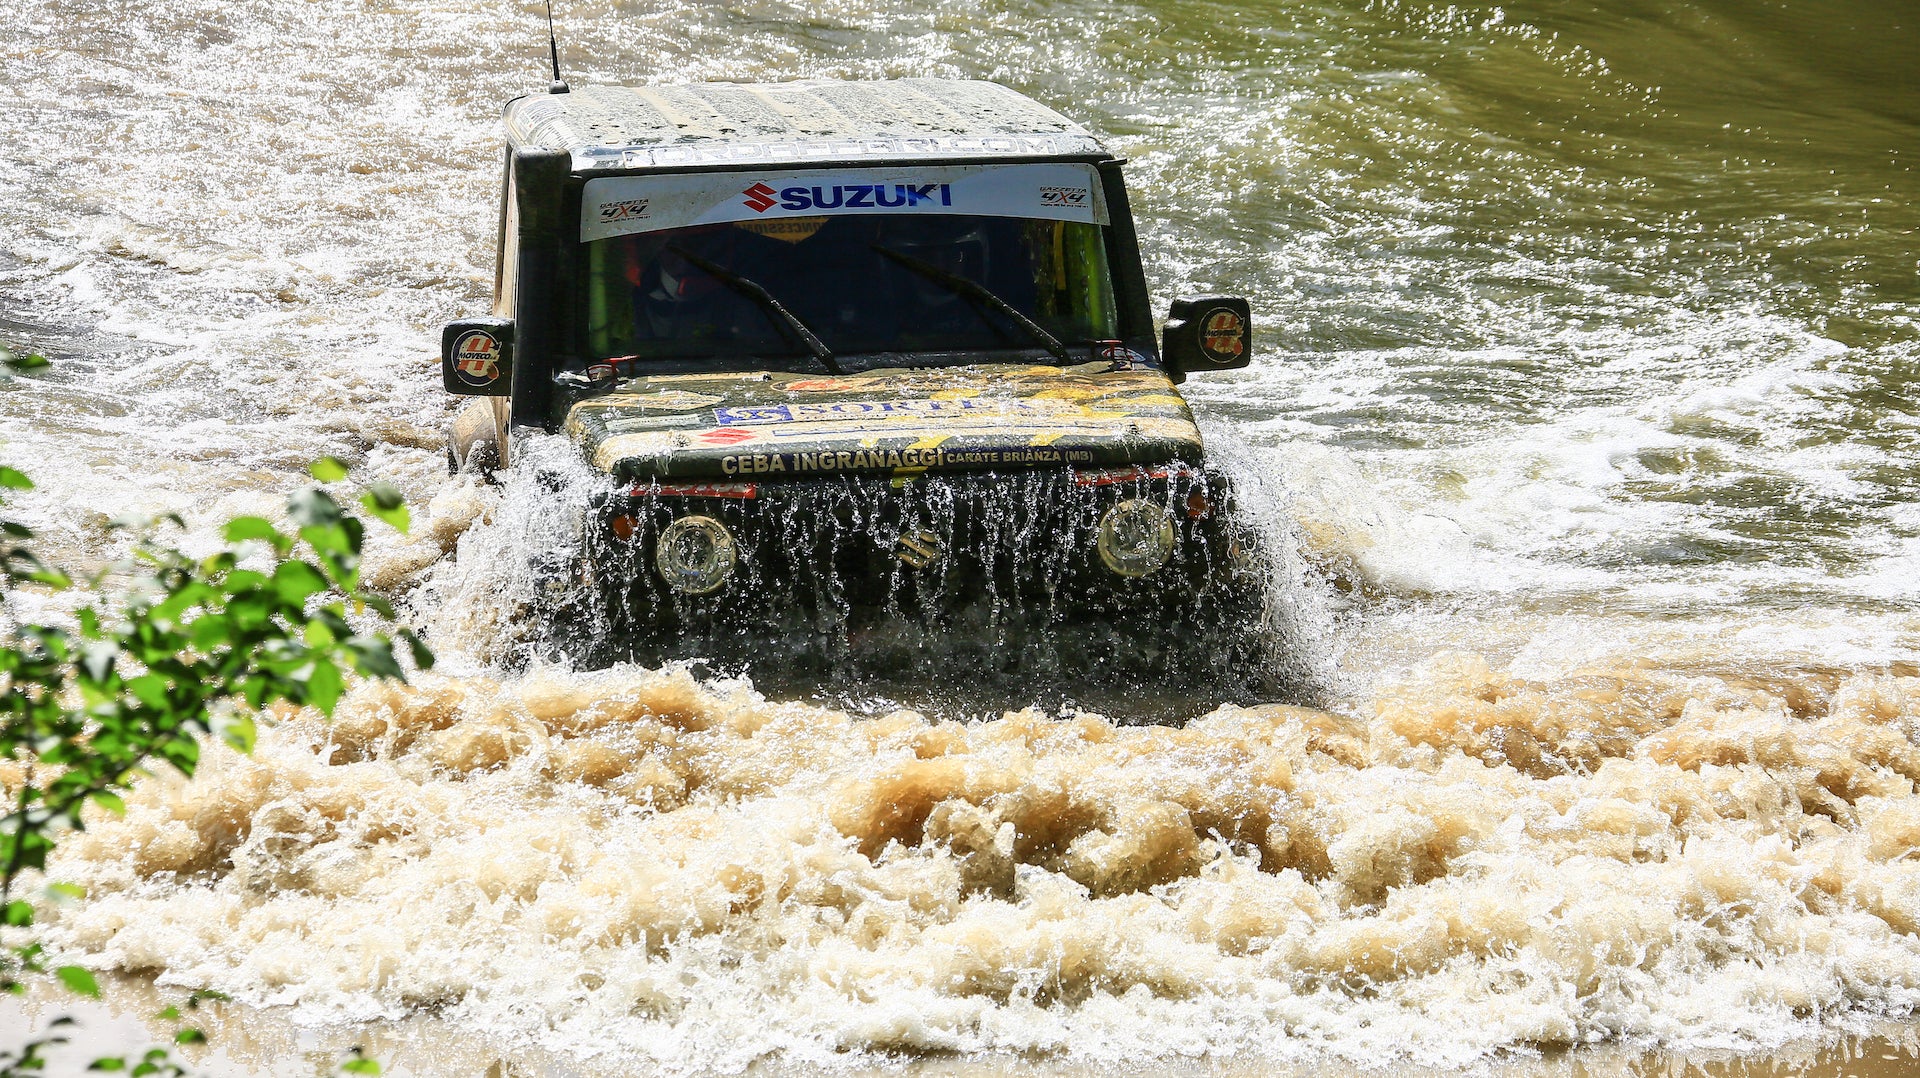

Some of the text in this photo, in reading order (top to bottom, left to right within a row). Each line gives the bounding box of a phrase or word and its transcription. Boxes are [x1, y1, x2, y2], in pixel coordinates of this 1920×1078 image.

[780, 183, 952, 211] SUZUKI
[721, 453, 786, 475] CEBA
[793, 447, 944, 471] INGRANAGGI
[947, 452, 999, 464] CARATE
[1065, 450, 1093, 463] (MB)
